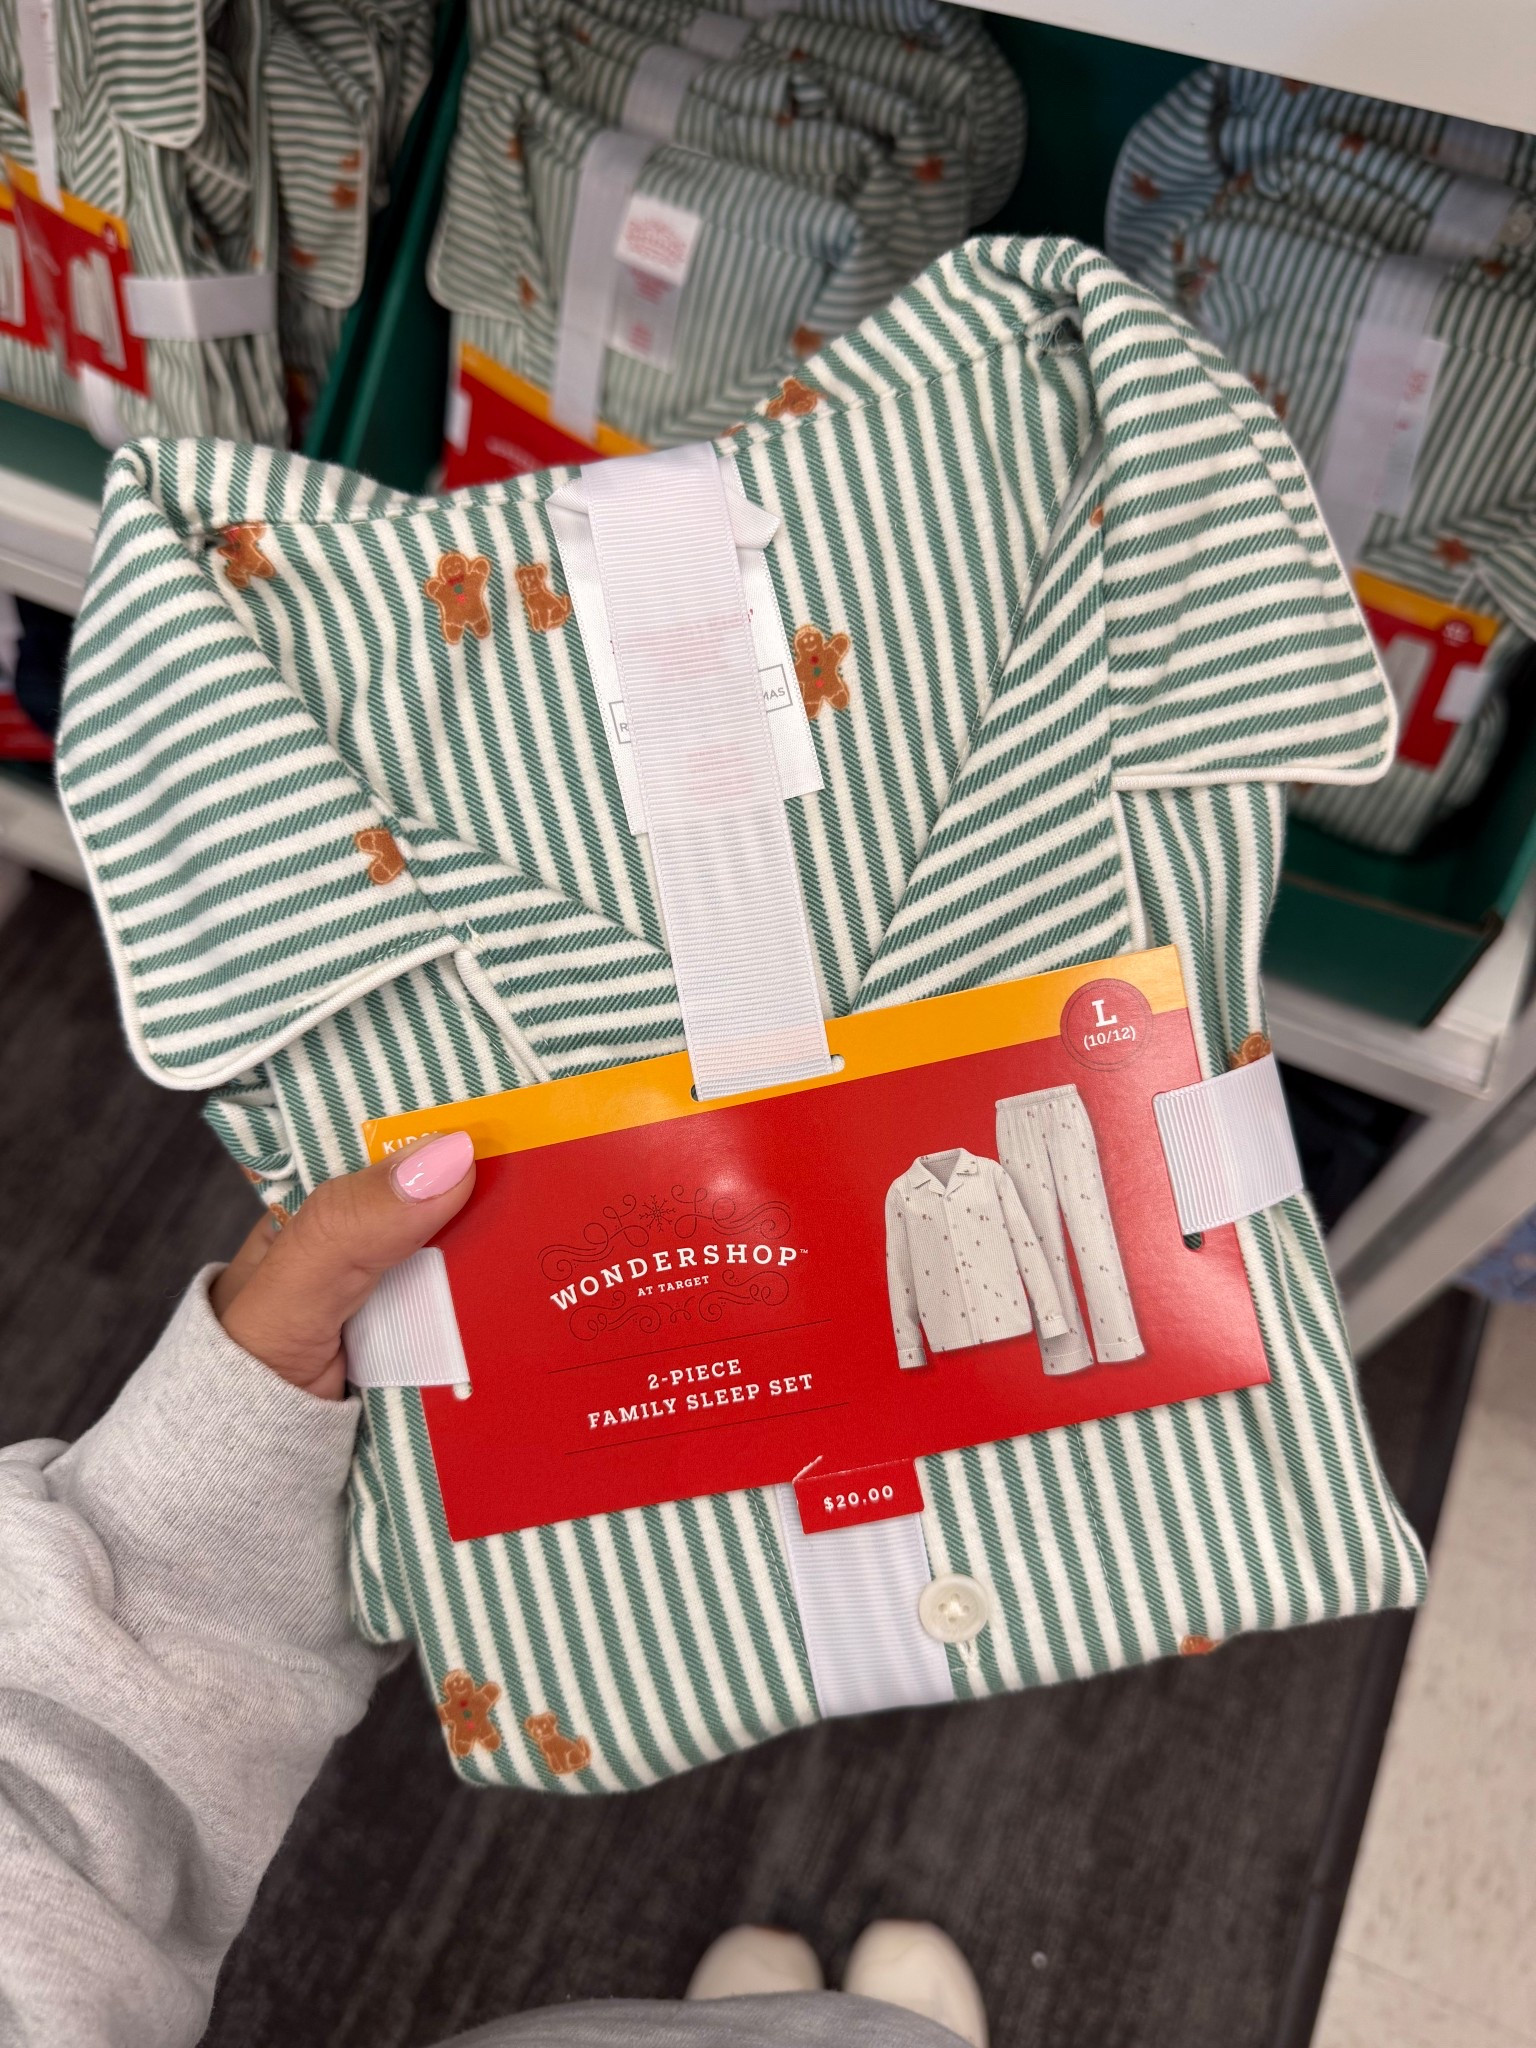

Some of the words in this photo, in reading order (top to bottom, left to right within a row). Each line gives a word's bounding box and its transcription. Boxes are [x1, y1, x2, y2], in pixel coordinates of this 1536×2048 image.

[1091, 999, 1118, 1028] L
[1083, 1025, 1136, 1051] (10/12)
[637, 1286, 654, 1297] AT
[657, 1275, 710, 1293] TARGET
[648, 1358, 742, 1390] 2-PIECE
[587, 1397, 677, 1430] FAMILY
[686, 1383, 760, 1412] SLEEP
[769, 1373, 813, 1397] SET
[823, 1484, 894, 1513] $20.00
